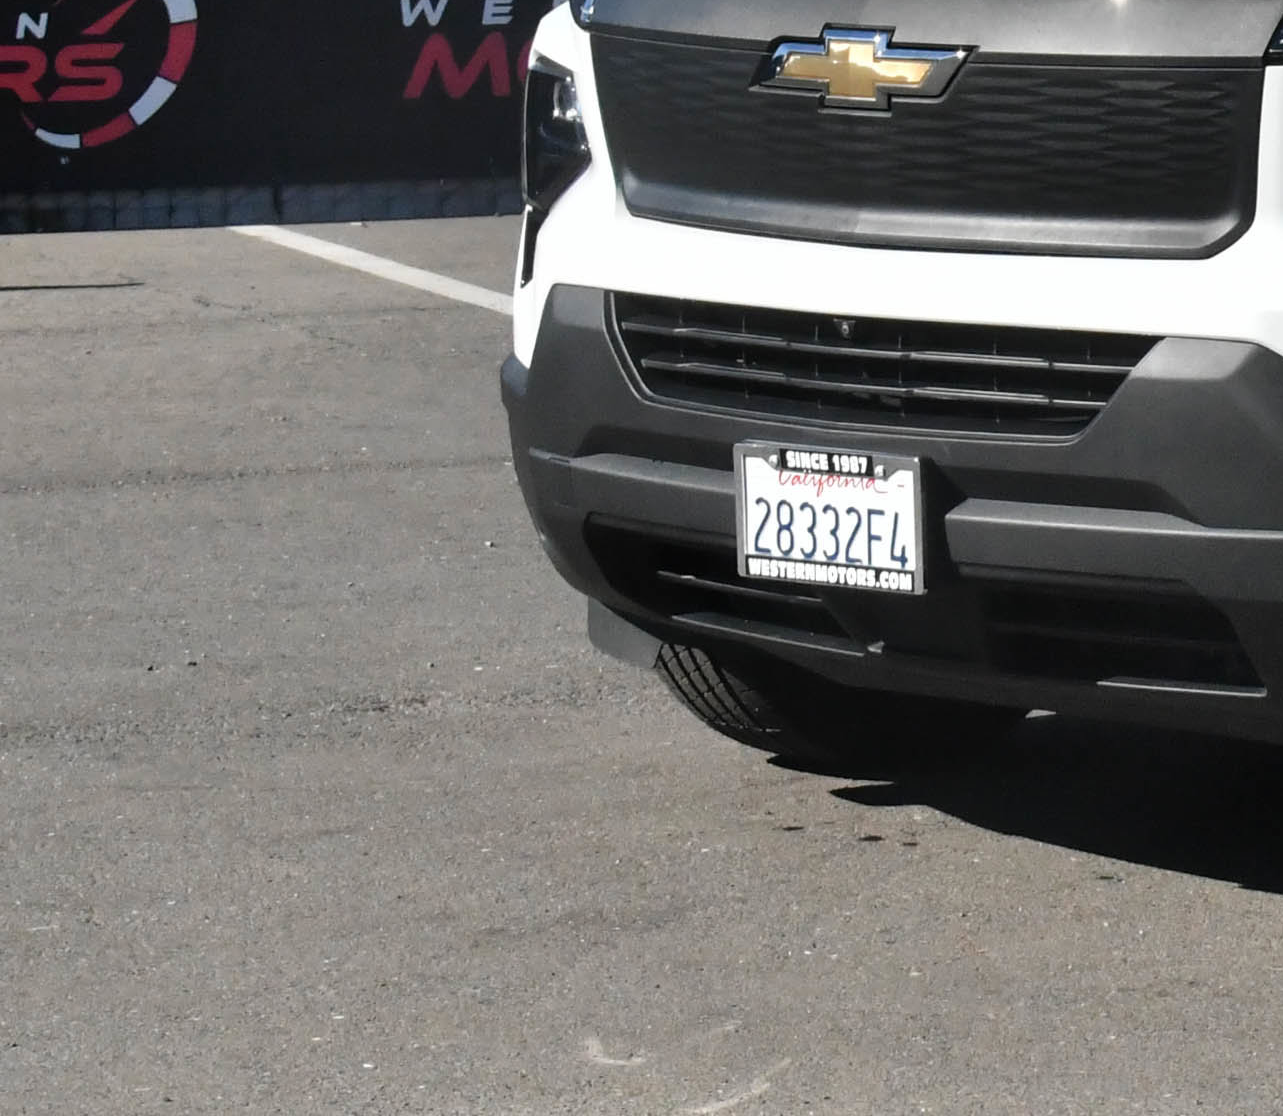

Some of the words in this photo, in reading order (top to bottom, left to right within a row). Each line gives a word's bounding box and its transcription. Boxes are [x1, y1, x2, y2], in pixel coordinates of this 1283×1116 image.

[785, 450, 829, 471] SINCE
[832, 454, 868, 474] 1987
[754, 497, 908, 568] 28332F4
[748, 558, 913, 591] WESTERNMOTORS.COM
